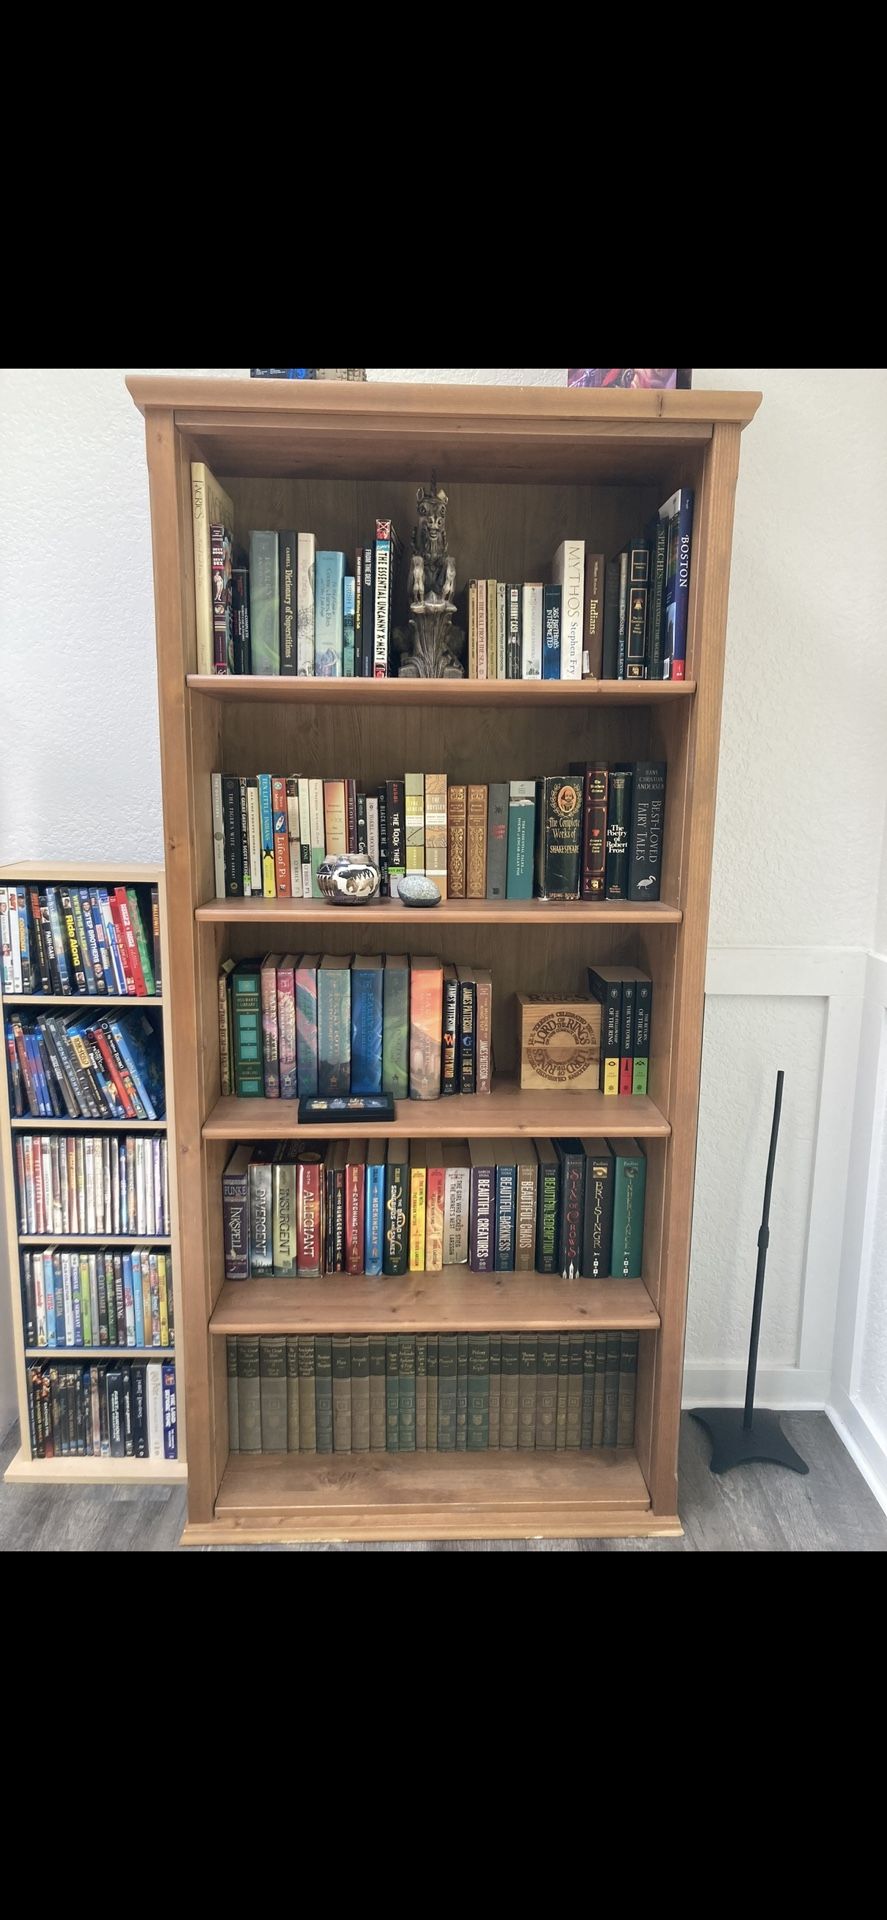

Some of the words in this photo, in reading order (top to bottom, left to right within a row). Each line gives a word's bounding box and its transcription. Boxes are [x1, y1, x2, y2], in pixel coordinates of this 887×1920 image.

[377, 553, 388, 565] THE
[656, 530, 666, 579] SPEECHES
[679, 537, 690, 588] BOSTON
[284, 570, 294, 605] Dictionary
[377, 567, 388, 599] ESSENTIAL
[567, 547, 581, 617] MYTHOS
[285, 607, 293, 615] of
[376, 601, 387, 633] UNCANNY
[589, 599, 598, 635] Indians
[284, 615, 294, 658] Superstitions
[510, 621, 518, 633] CASH
[568, 622, 579, 656] Stephen
[376, 634, 387, 656] X-MEN
[568, 659, 578, 675] Fry
[549, 817, 557, 827] The
[559, 817, 580, 829] Complete
[611, 824, 624, 832] The
[636, 803, 649, 828] FAIRY
[392, 828, 400, 846] BOOK
[551, 829, 570, 839] Works
[570, 828, 577, 842] of
[607, 830, 627, 838] Poetry
[649, 800, 662, 863] BEST-LOVED
[278, 856, 285, 864] of
[393, 849, 401, 865] THIEF
[550, 845, 579, 854] SHAKESPEARE
[635, 832, 648, 861] TALES
[279, 869, 286, 878] Pi
[72, 895, 80, 915] WE'RE
[65, 915, 74, 938] Ride
[84, 912, 92, 928] STEP
[47, 946, 55, 959] GAIN
[69, 938, 80, 966] Along
[87, 929, 99, 962] BROTHERS
[448, 984, 457, 1002] JAMES
[463, 987, 473, 1004] JAMES
[447, 1003, 457, 1031] PATTERSON
[463, 1005, 472, 1033] PATTERSON
[608, 1008, 614, 1017] OF
[638, 1009, 643, 1018] OF
[534, 1019, 557, 1045] LORD
[567, 1018, 590, 1045] RINGS
[479, 1040, 488, 1055] JAMES
[56, 1040, 70, 1069] WONDER
[68, 1071, 82, 1096] WOMAN
[463, 1066, 472, 1075] GIFT
[480, 1056, 488, 1079] PATTERSON
[224, 1185, 247, 1196] FUNKE
[477, 1179, 490, 1216] BEAUTIFUL
[499, 1177, 512, 1214] BEAUTIFUL
[520, 1181, 534, 1221] BEAUTIFUL
[543, 1177, 556, 1212] BEAUTIFUL
[255, 1189, 266, 1256] DIVERGENT
[279, 1187, 290, 1255] INSURGENT
[303, 1190, 314, 1257] ALLEGIANT
[592, 1181, 604, 1248] BRISINGR
[624, 1179, 634, 1249] INHERITANCE
[228, 1207, 243, 1249] INKSPELL
[476, 1218, 489, 1257] CREATURES
[498, 1216, 511, 1251] DARKNESS
[519, 1223, 532, 1248] CHAOS
[543, 1213, 555, 1253] REDEMPTION
